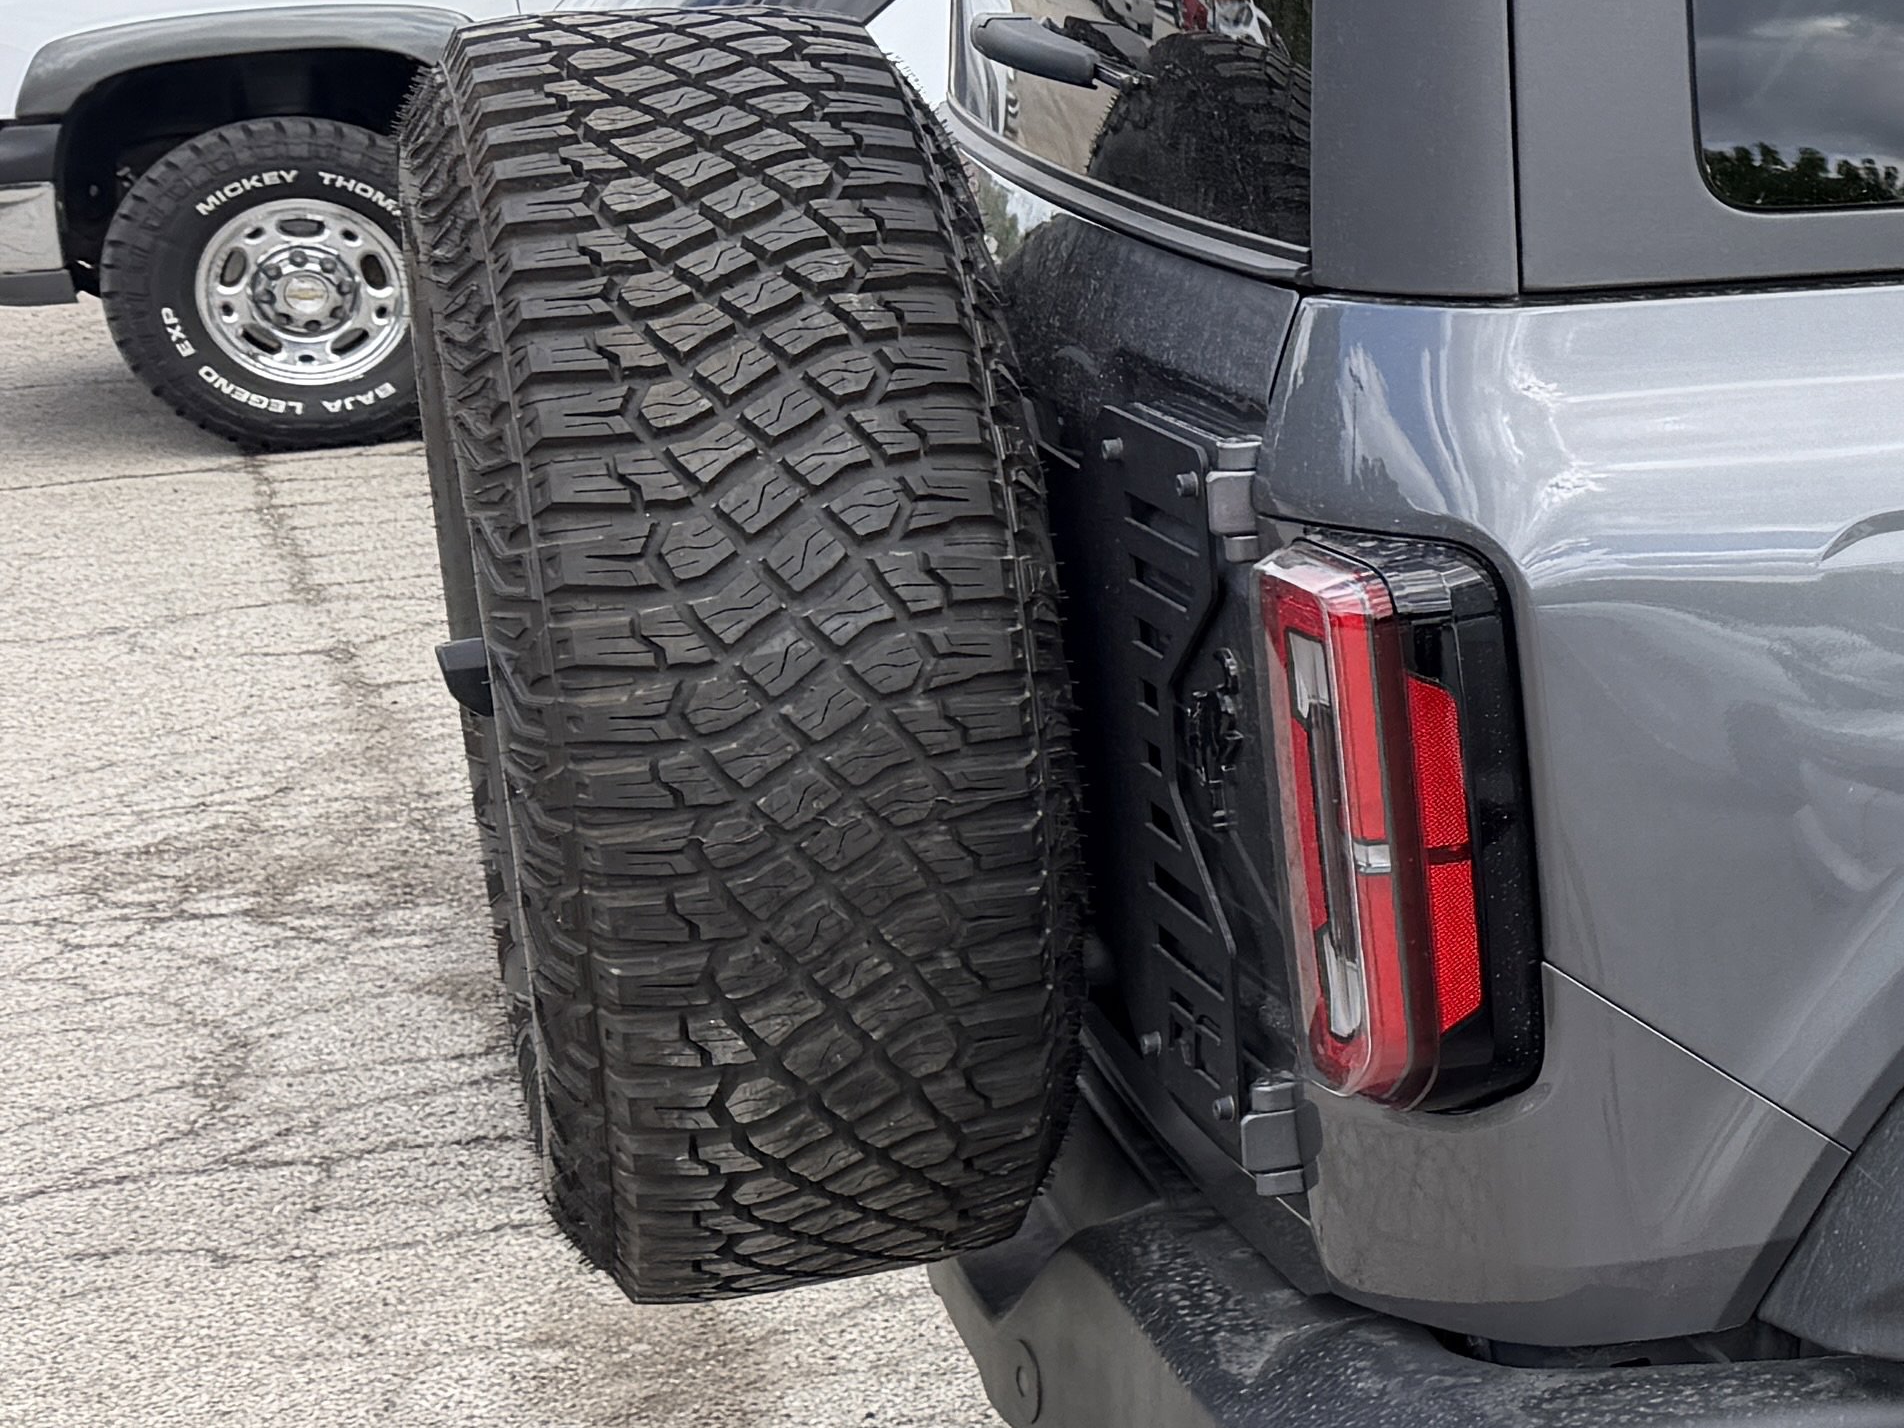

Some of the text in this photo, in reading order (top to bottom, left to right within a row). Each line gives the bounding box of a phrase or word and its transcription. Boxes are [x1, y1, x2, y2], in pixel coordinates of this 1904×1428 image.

[195, 169, 299, 217] MICKEY
[160, 306, 398, 416] BAJA LEGEND EXP
